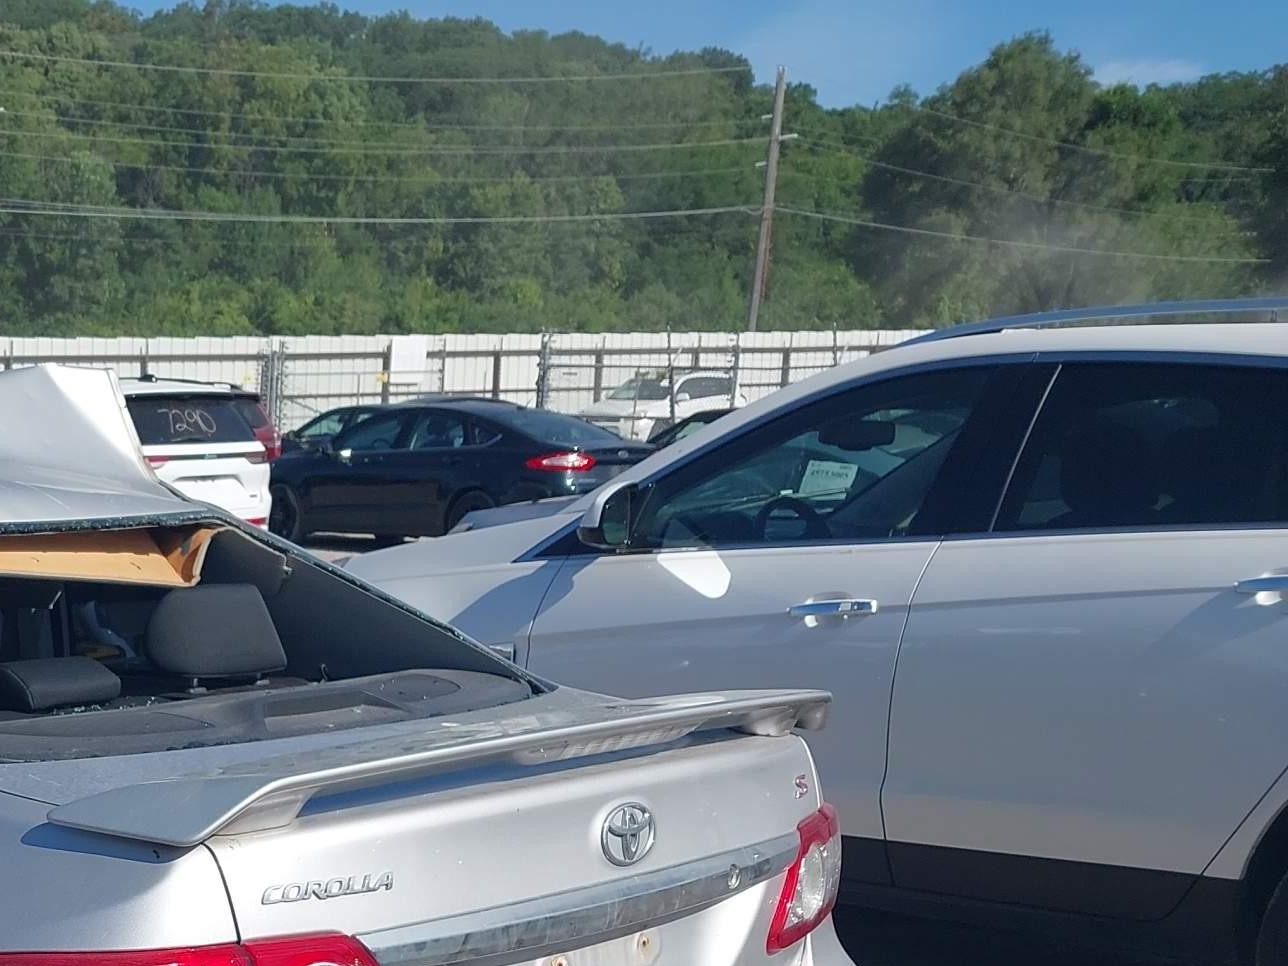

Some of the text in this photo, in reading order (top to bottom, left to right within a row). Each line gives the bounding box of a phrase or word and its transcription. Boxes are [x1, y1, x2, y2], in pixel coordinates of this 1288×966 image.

[157, 407, 217, 434] 7290
[794, 773, 809, 800] S
[260, 871, 394, 905] COROLLA
